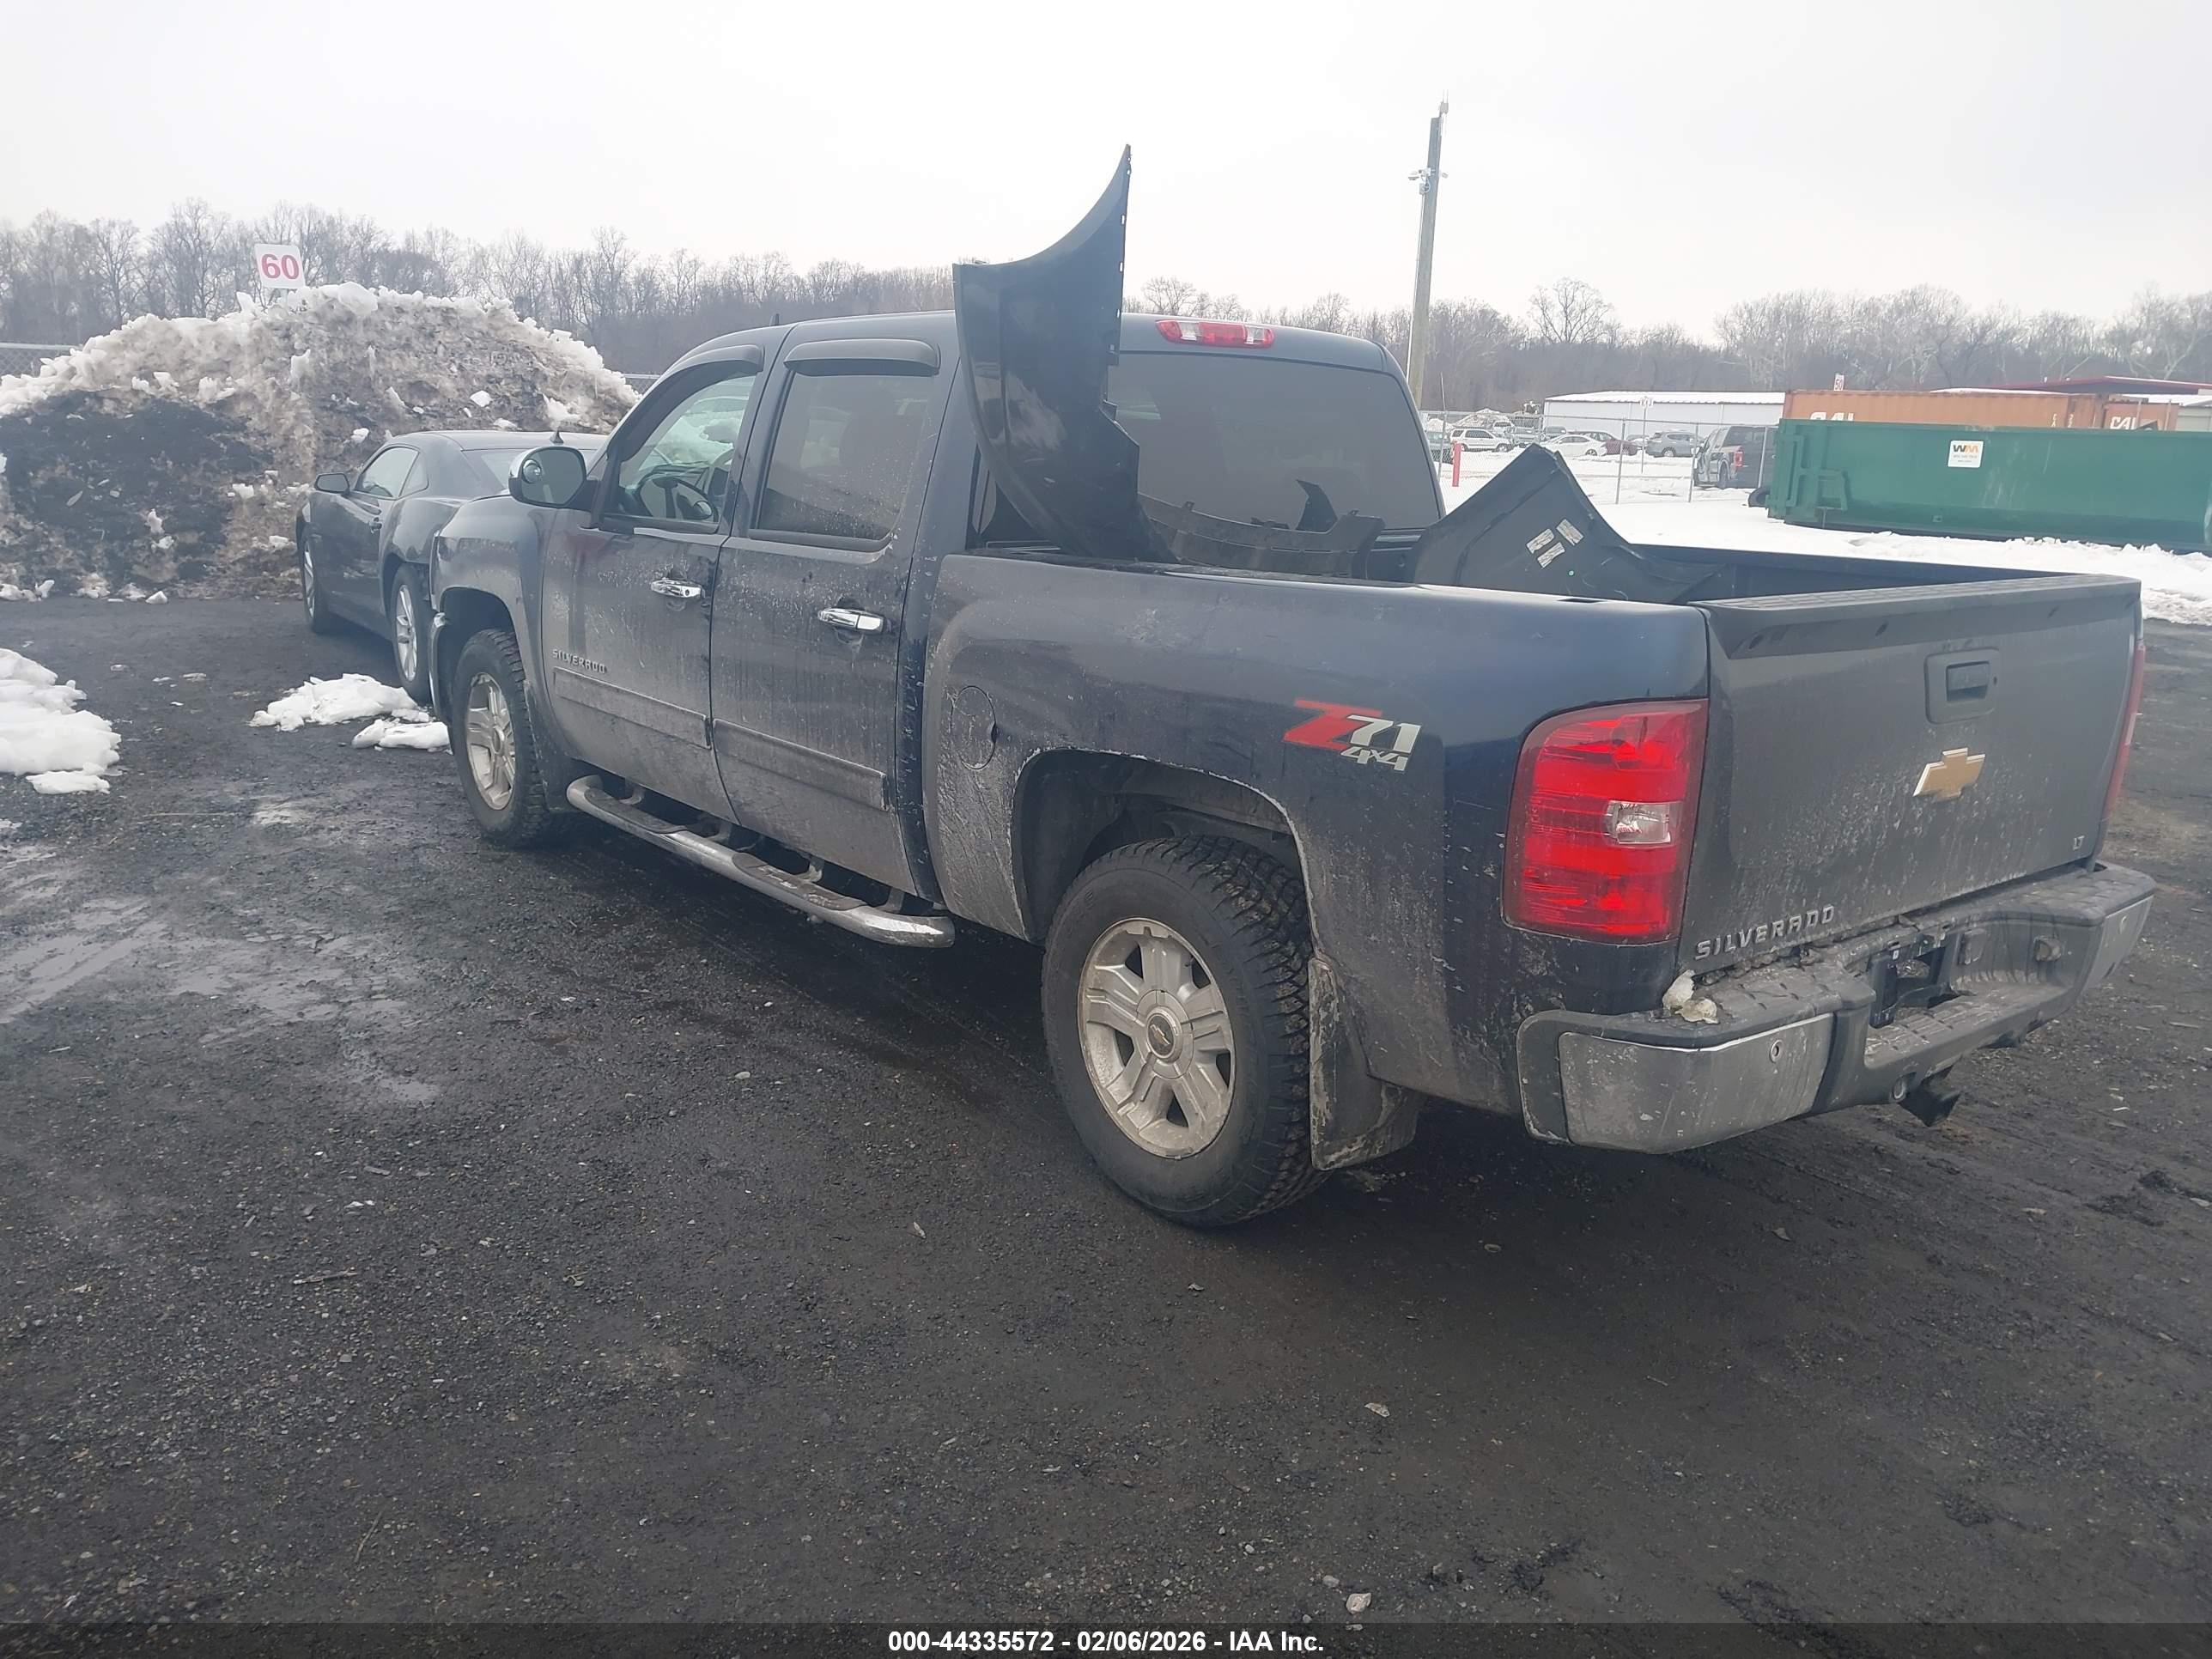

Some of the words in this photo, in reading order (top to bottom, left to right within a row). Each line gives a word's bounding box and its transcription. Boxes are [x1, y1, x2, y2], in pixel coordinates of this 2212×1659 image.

[261, 253, 300, 280] 60
[1953, 444, 1979, 453] WM
[552, 648, 606, 674] SILVERADO
[1282, 699, 1422, 754] Z71
[1694, 904, 1835, 961] SILVERADO
